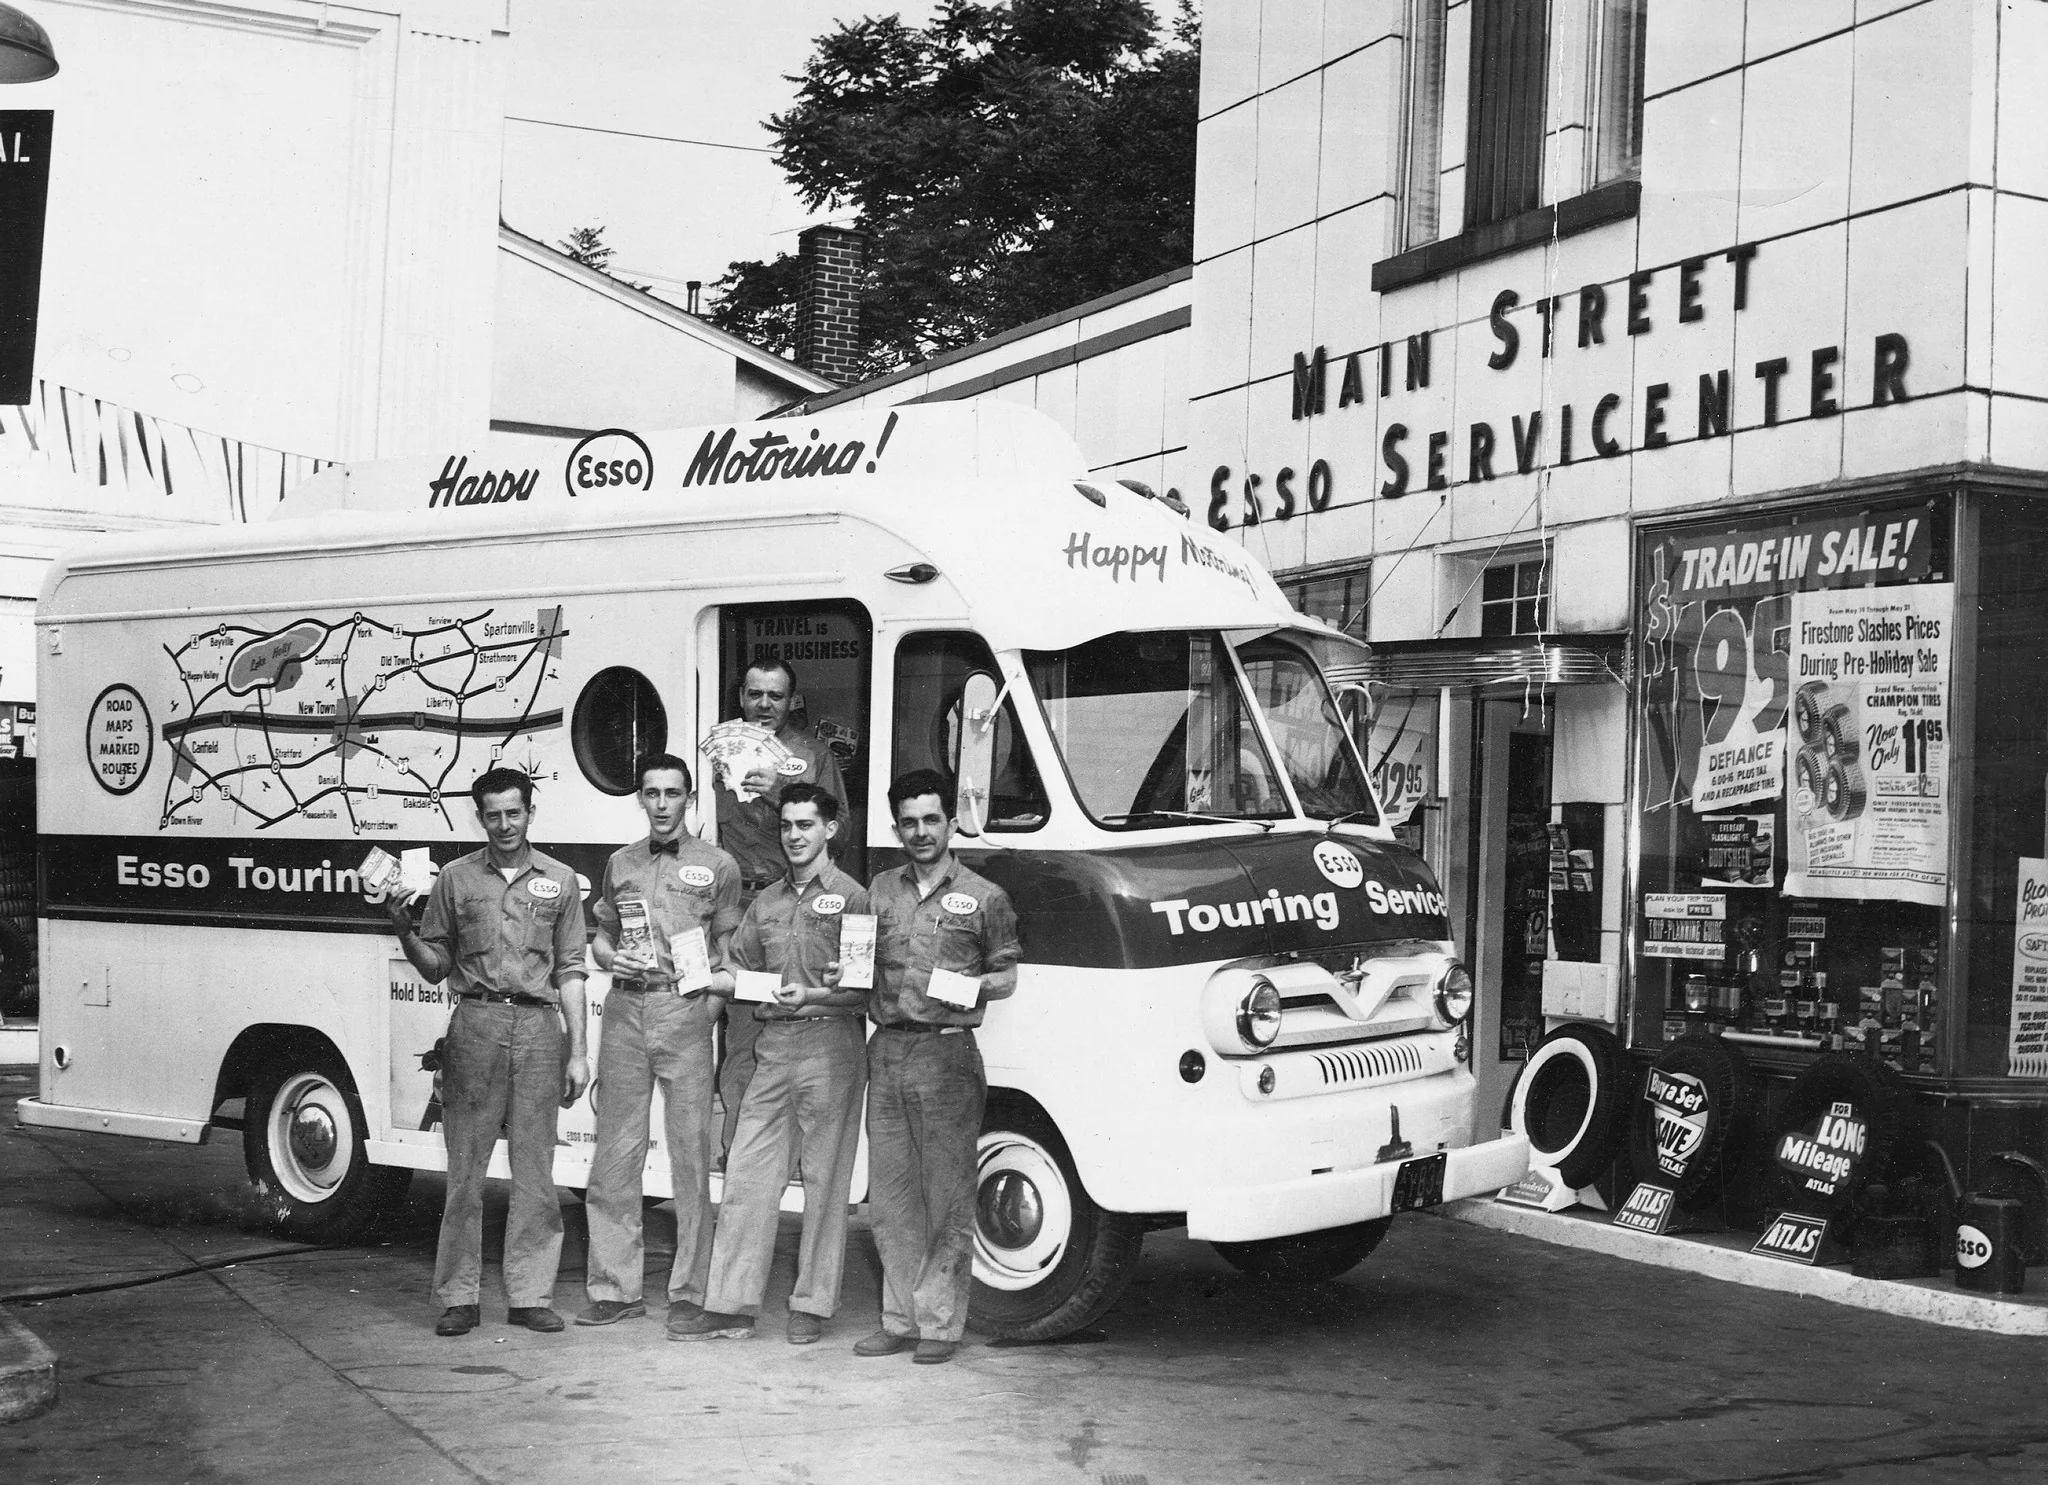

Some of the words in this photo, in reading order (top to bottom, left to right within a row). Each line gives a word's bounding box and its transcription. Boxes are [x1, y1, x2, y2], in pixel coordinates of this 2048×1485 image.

[1291, 331, 1430, 421] MAIN
[1487, 242, 1757, 370] STREET
[1208, 458, 1333, 530] ESSO
[1380, 331, 1911, 498] SERVICENTER
[1062, 532, 1168, 583] Happy
[1681, 534, 1812, 591] TRADE-IN
[1817, 519, 1919, 576] SALE!
[428, 616, 452, 625] Fairview
[754, 617, 812, 637] TRAVEL
[816, 623, 828, 635] IS
[357, 628, 372, 638] York
[484, 621, 535, 638] Spartonville
[1802, 621, 1854, 645] Firestone
[1858, 617, 1902, 642] Slashes
[1906, 615, 1940, 640] Prices
[210, 637, 234, 649] Bayville
[443, 644, 451, 655] 15
[754, 642, 779, 660] BIG
[784, 640, 860, 660] BUSINESS
[250, 656, 266, 672] Lake
[315, 655, 342, 668] Sunnyside
[381, 656, 392, 666] Old
[394, 655, 411, 666] Town
[479, 653, 517, 664] Strathmore
[1800, 653, 1838, 680] During
[1844, 650, 1913, 678] Pre-Holiday
[1917, 648, 1938, 673] Sale
[187, 671, 202, 682] Happy
[203, 670, 219, 681] Valley
[107, 700, 133, 713] ROAD
[426, 696, 453, 710] Liberty
[1867, 694, 1918, 707] CHAMPION
[1922, 694, 1941, 707] TIRES
[18, 707, 36, 720] Bu
[298, 701, 314, 715] New
[316, 701, 336, 715] Town
[106, 719, 133, 732] MAPS
[1866, 724, 1898, 752] Now
[100, 743, 140, 756] MARKED
[192, 741, 219, 754] Canfield
[275, 748, 302, 758] Stratford
[1872, 738, 1900, 771] Only
[247, 754, 257, 764] 25
[1709, 741, 1774, 772] DEFIANCE
[103, 763, 138, 775] ROUTES
[1737, 768, 1755, 781] PLUS
[1756, 765, 1767, 776] TAX
[553, 772, 559, 781] E
[1700, 791, 1715, 802] AND
[1716, 790, 1721, 800] A
[1722, 781, 1760, 798] RECAPPABLE
[1761, 777, 1775, 790] TIRE
[170, 816, 186, 825] Down
[187, 816, 203, 825] River
[302, 809, 338, 819] Pleasantville
[360, 820, 398, 830] Morristown
[117, 855, 210, 888] Esso
[228, 857, 388, 904] Touring
[2022, 878, 2048, 903] BLO
[1150, 888, 1340, 931] Touring
[1365, 880, 1448, 917] Service
[391, 981, 414, 1001] Hold
[418, 984, 443, 1004] back
[447, 992, 461, 1010] yo
[2039, 985, 2046, 993] TO
[2018, 1011, 2032, 1021] THIS
[2020, 1021, 2047, 1032] FEATURE
[2014, 1033, 2042, 1043] AGAINST
[2017, 1044, 2044, 1054] SUDDEN
[1650, 1072, 1669, 1101] Buy
[1666, 1085, 1677, 1100] a
[1675, 1085, 1703, 1111] Set
[1834, 1104, 1849, 1115] FOR
[583, 1133, 598, 1143] STAN
[1816, 1116, 1866, 1155] LONG
[1660, 1155, 1685, 1175] ATLAS
[1780, 1136, 1850, 1182] Mileage
[1805, 1178, 1835, 1195] ATLAS
[1627, 1187, 1669, 1215] ATLAS
[1620, 1211, 1657, 1229] TIRES
[1762, 1223, 1821, 1253] ATLAS
